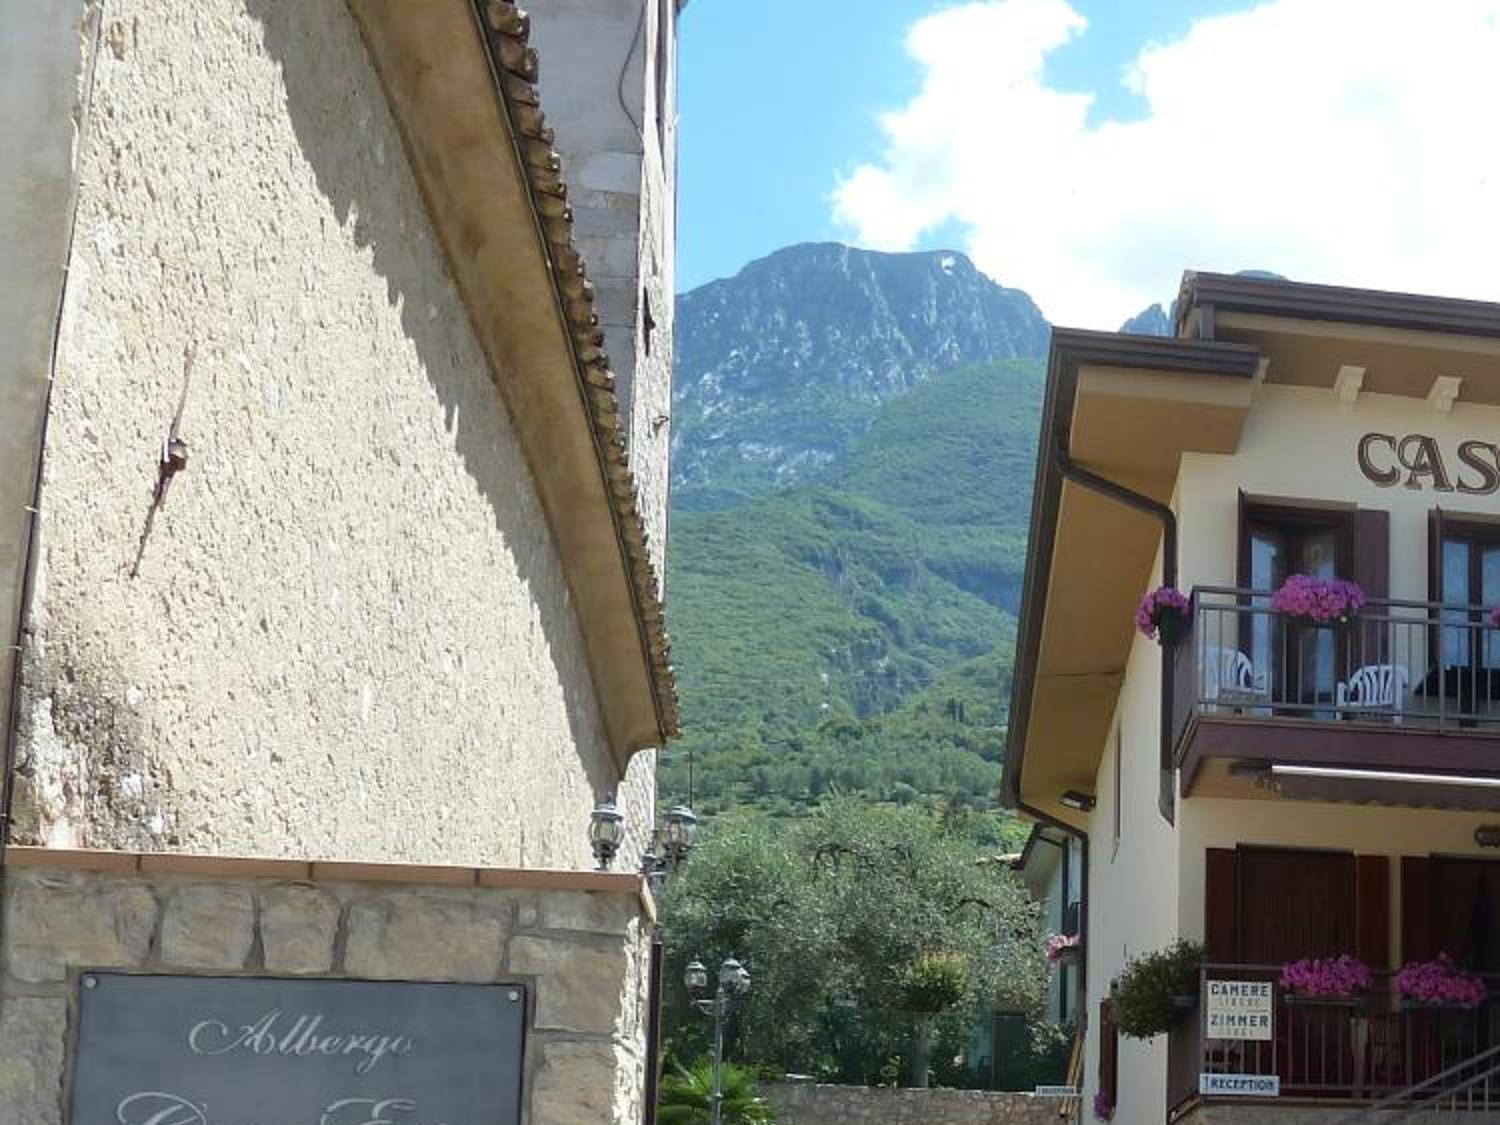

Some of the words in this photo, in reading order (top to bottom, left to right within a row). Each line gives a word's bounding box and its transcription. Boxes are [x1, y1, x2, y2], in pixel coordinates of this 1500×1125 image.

[1211, 984, 1269, 997] CAMERE
[1211, 1015, 1269, 1028] ZIMMER
[189, 1009, 415, 1074] Albergo
[1210, 1078, 1274, 1091] RECEPTION
